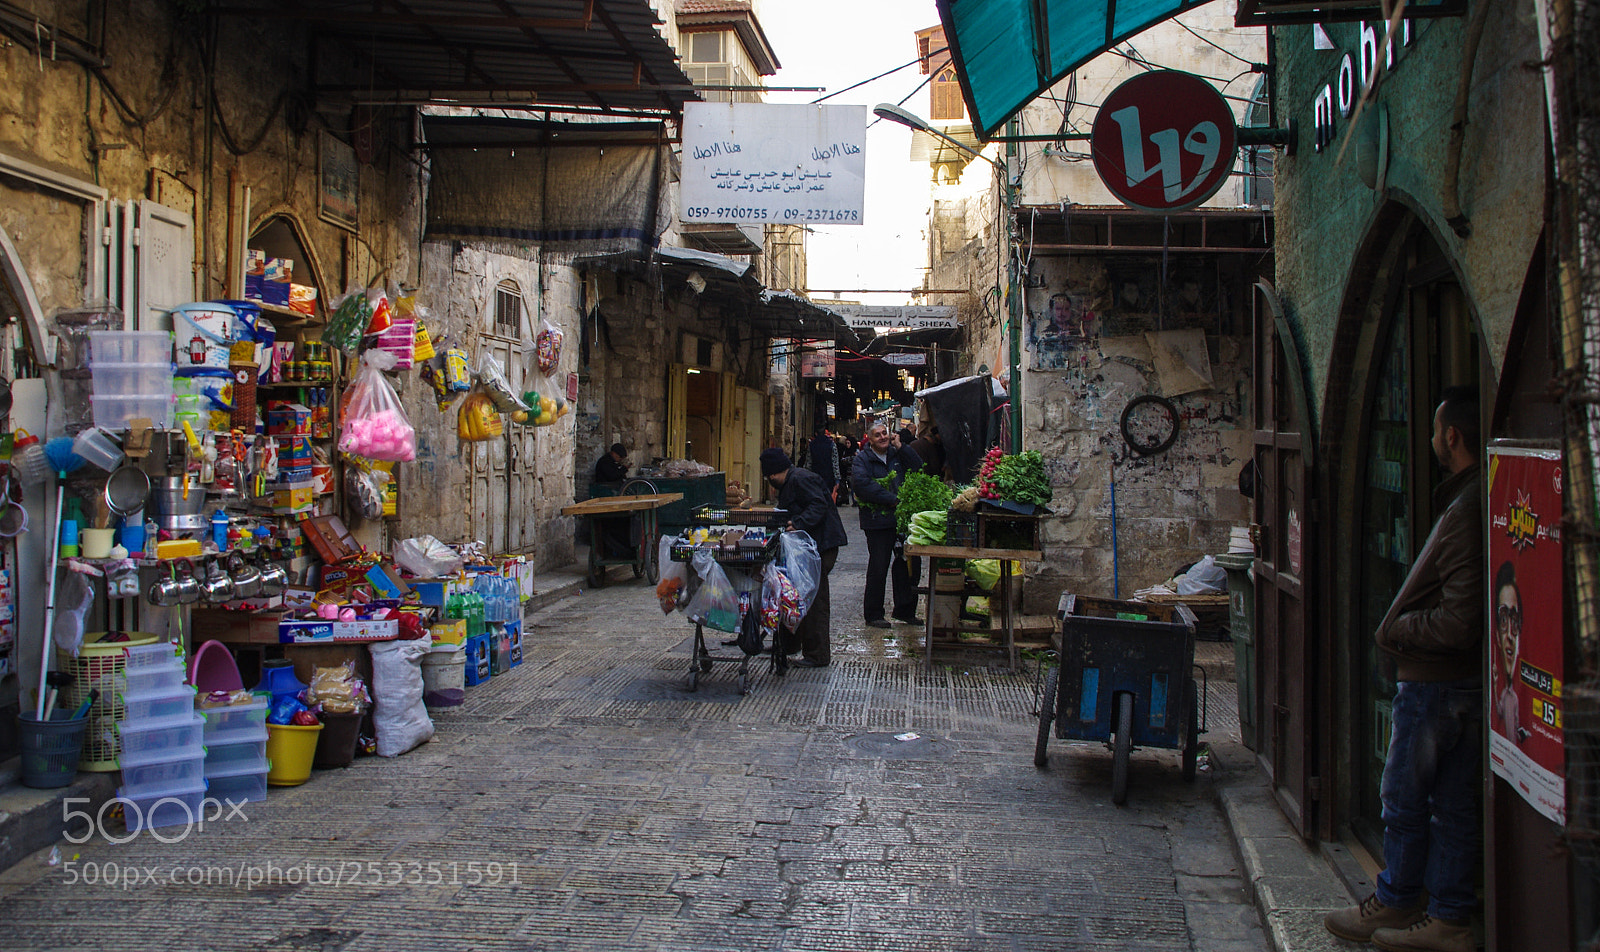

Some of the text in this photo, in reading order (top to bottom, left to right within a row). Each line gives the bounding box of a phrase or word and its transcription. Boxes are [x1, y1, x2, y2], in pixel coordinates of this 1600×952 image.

[722, 141, 742, 154] هنا
[687, 206, 768, 220] 059-9700755
[783, 208, 859, 221] 09-2371678
[852, 319, 892, 328] HAMAM
[897, 319, 911, 328] AL
[918, 320, 952, 328] SHEFA
[1543, 701, 1555, 726] 15
